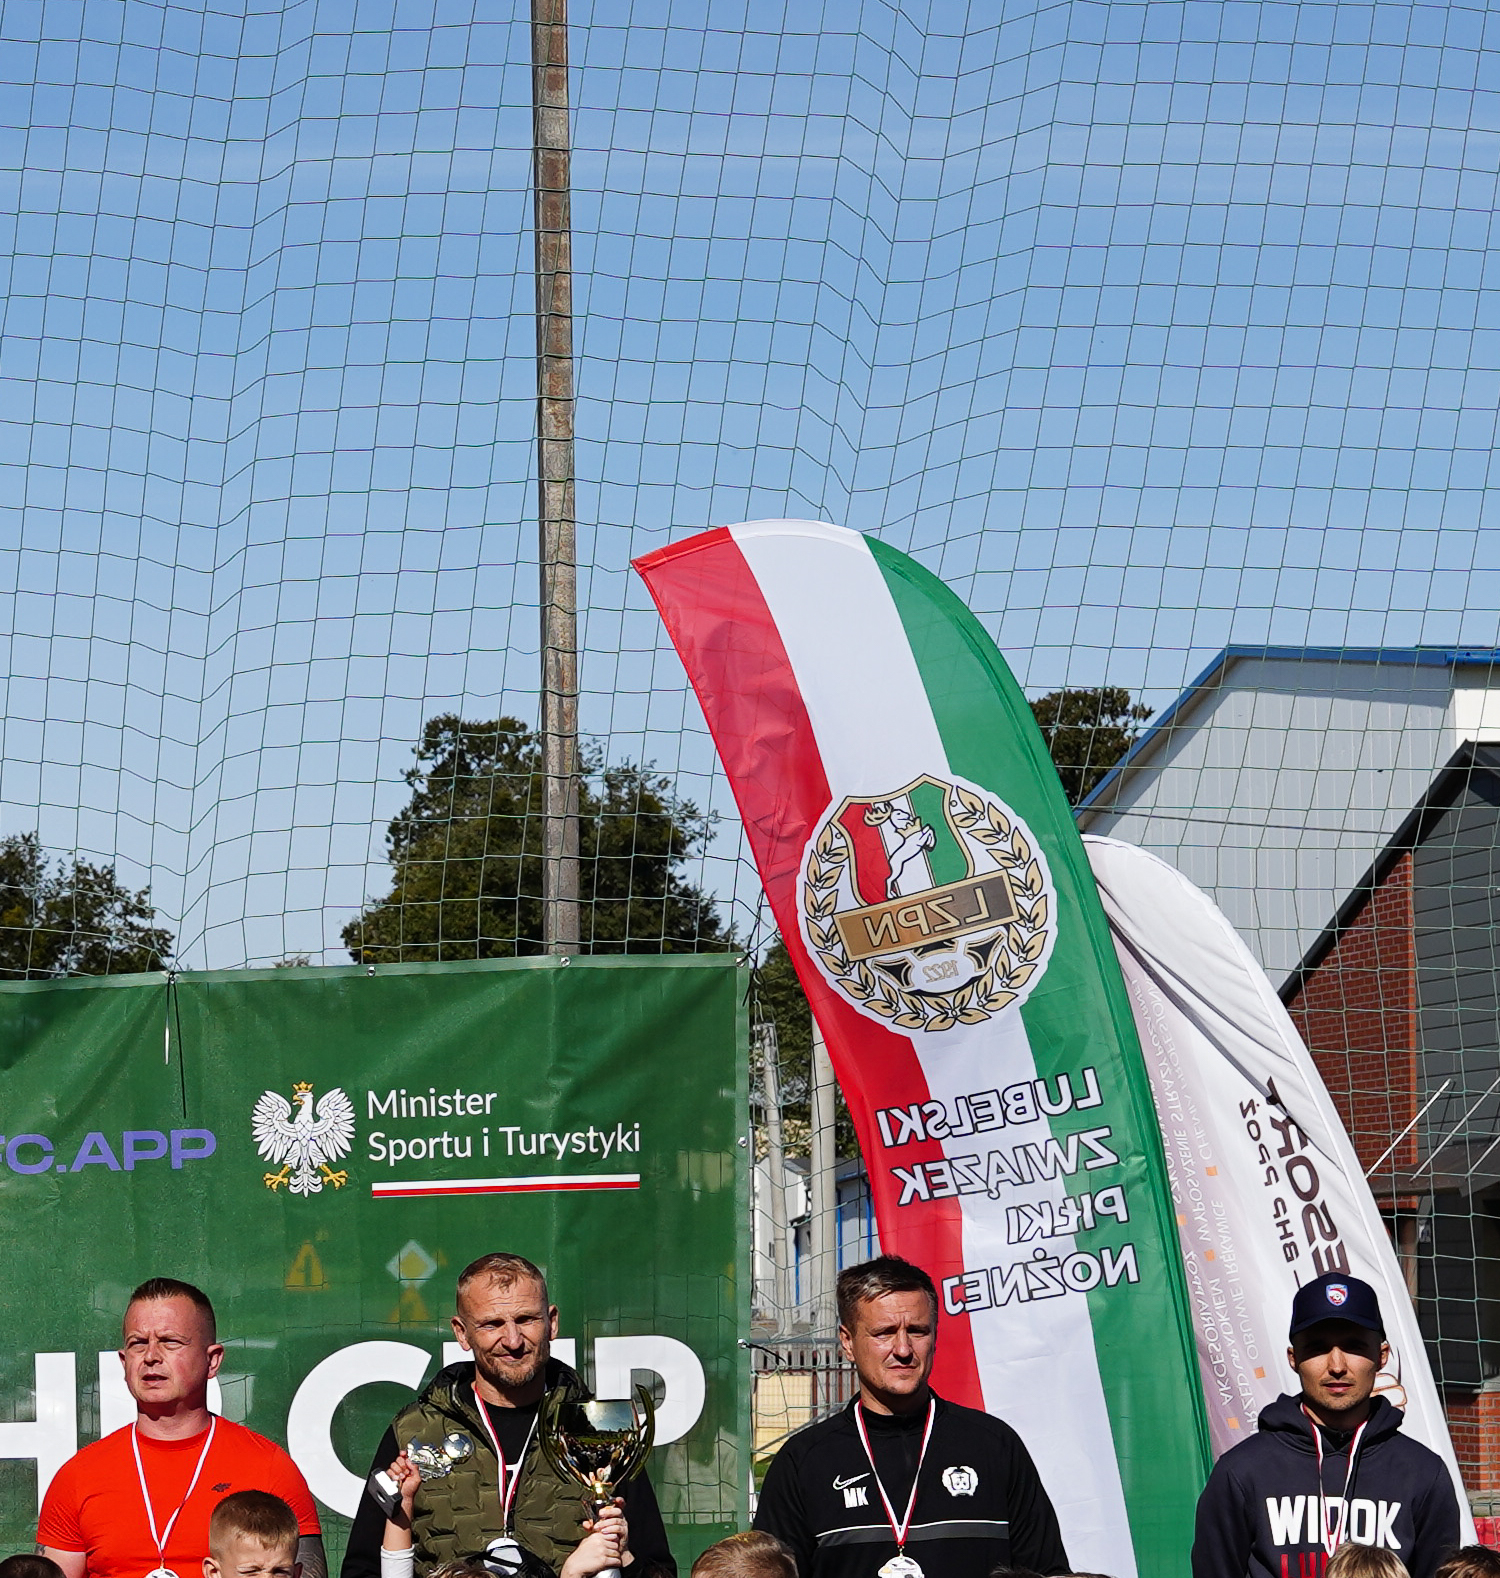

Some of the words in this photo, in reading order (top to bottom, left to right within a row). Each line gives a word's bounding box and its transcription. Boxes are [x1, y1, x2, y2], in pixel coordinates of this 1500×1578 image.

[368, 1089, 497, 1120] Minister
[368, 1130, 474, 1166] Sportu
[482, 1127, 491, 1158] i
[500, 1123, 641, 1162] Turystyki
[286, 1334, 706, 1520] CP
[844, 1487, 869, 1509] MK
[1266, 1495, 1402, 1550] WIDOK
